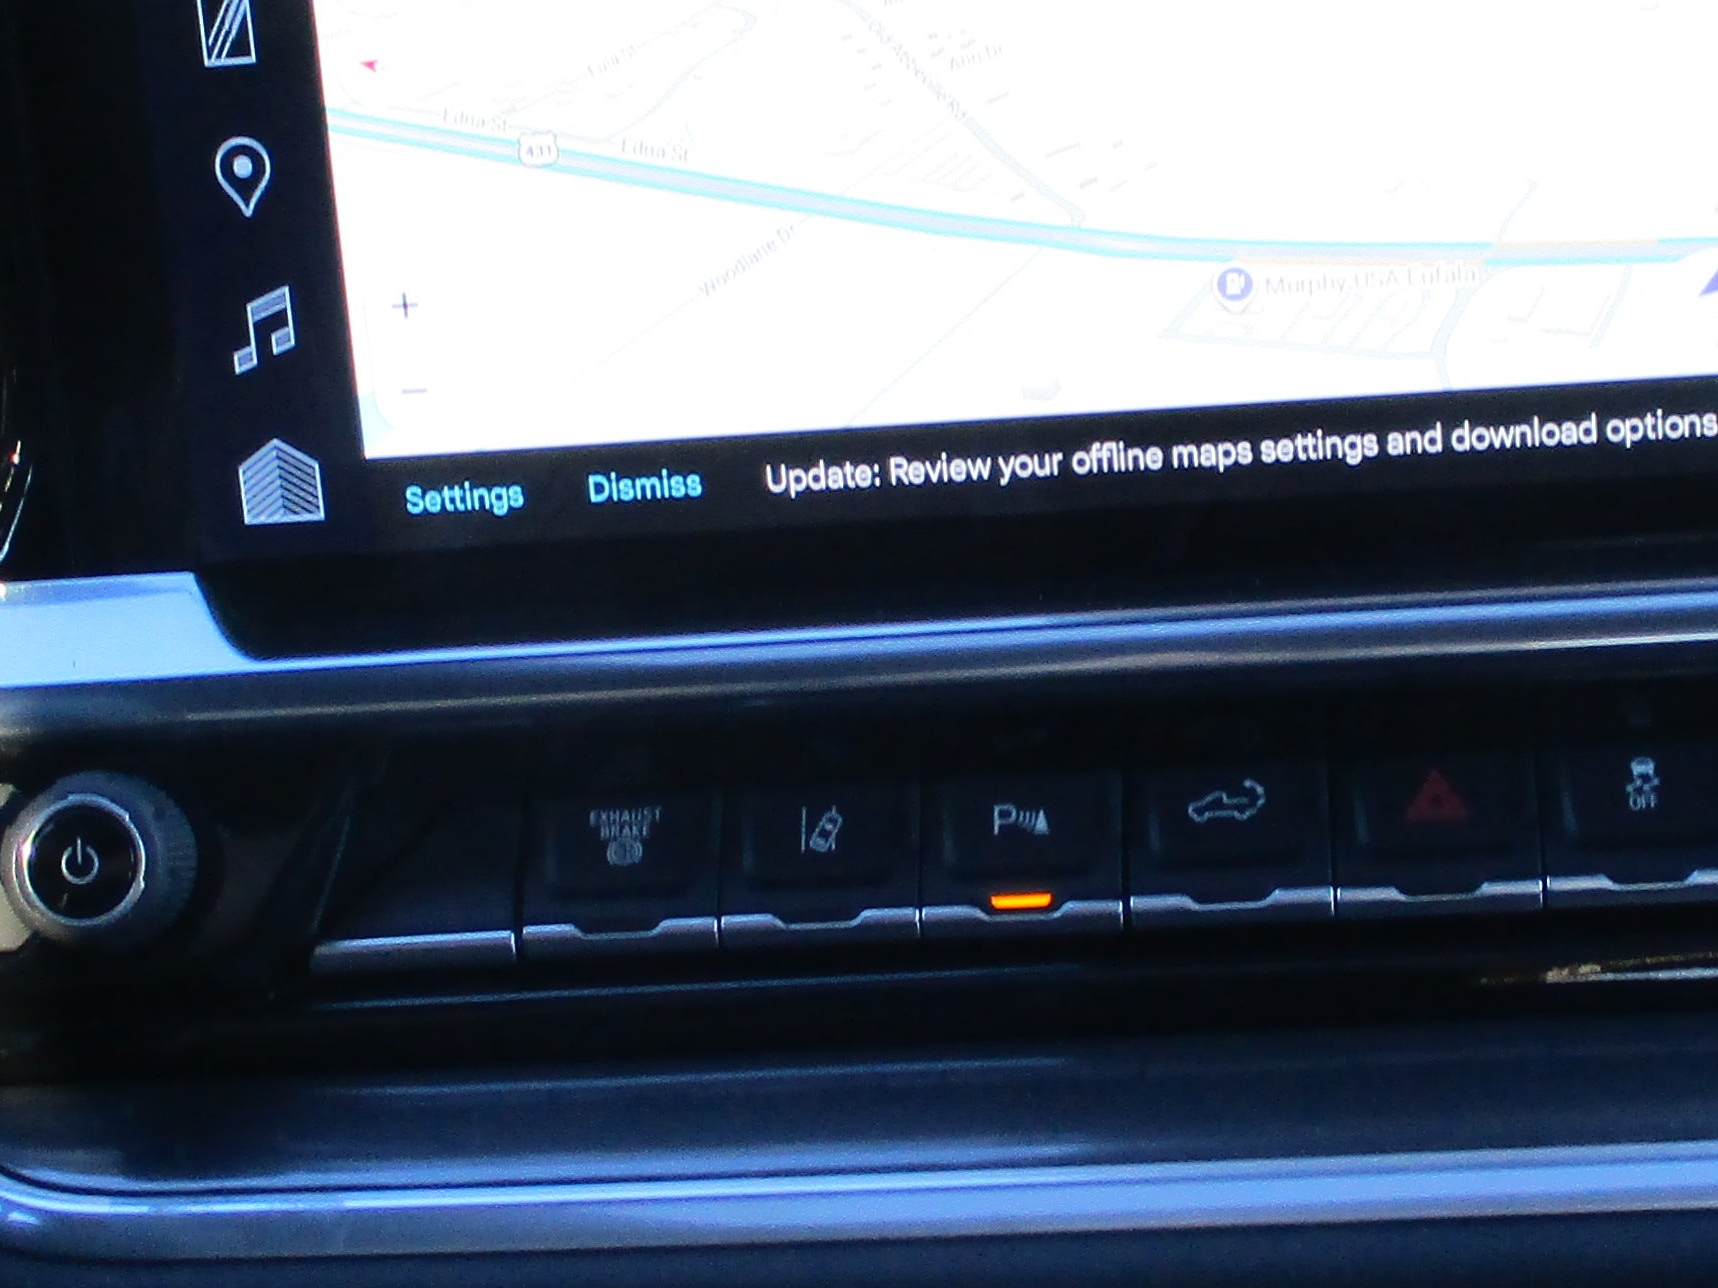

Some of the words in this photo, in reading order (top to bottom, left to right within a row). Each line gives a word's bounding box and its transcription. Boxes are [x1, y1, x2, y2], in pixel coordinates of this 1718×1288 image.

[765, 461, 882, 496] Update:
[889, 454, 993, 487] Review
[999, 451, 1063, 485] your
[1071, 443, 1165, 476] offline
[1173, 441, 1253, 474] maps
[1261, 428, 1379, 466] settings
[1387, 422, 1444, 456] and
[1452, 412, 1598, 450] download
[404, 482, 525, 516] Settings
[587, 470, 703, 504] Dismiss
